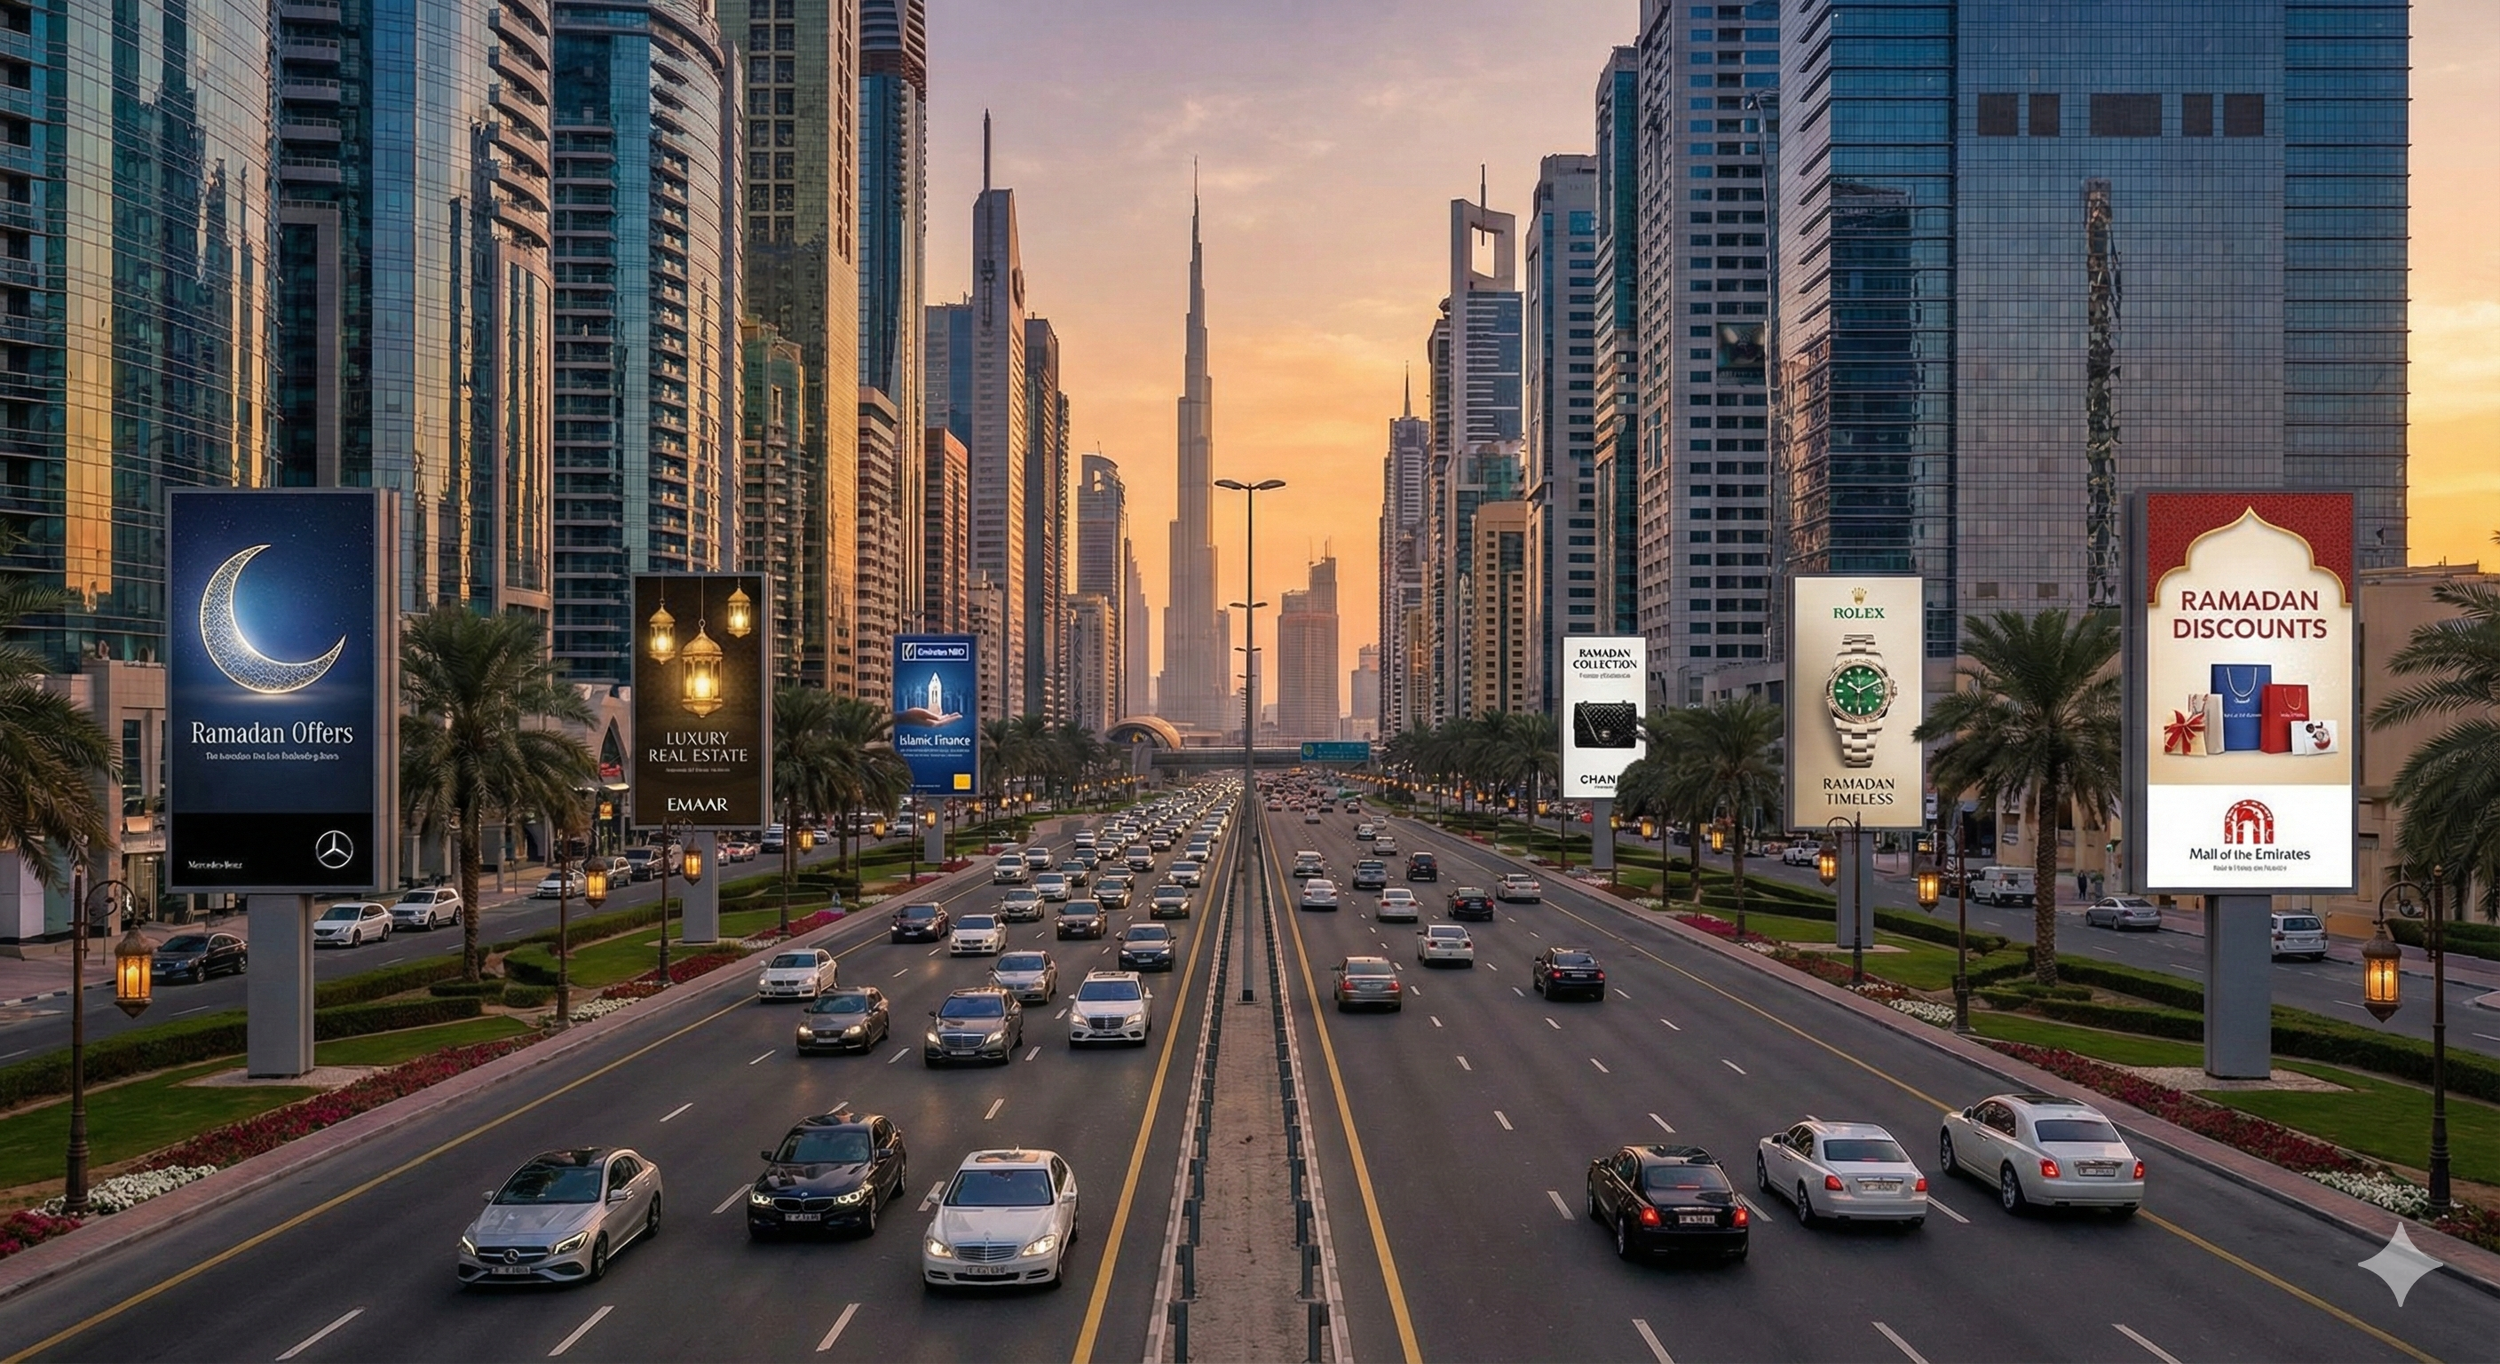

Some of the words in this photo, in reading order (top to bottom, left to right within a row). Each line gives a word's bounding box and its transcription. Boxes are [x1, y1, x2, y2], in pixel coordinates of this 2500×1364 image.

[2181, 590, 2319, 611] RAMADAN
[1833, 607, 1885, 619] ROLEX
[2173, 618, 2328, 639] DISCOUNTS
[1579, 648, 1631, 658] RAMADAN
[1573, 659, 1637, 669] COLLECTION
[191, 721, 285, 744] Ramadan
[292, 721, 354, 744] Offers
[666, 731, 730, 746] LUXURY
[899, 733, 933, 746] Islamic
[934, 733, 971, 746] Finance
[649, 748, 687, 762] REAL
[693, 748, 748, 762] ESTATE
[1823, 778, 1895, 790] RAMADAN
[667, 797, 729, 812] EMAAR
[1825, 793, 1894, 805] TIMELESS
[2189, 848, 2217, 860] Mall
[2220, 849, 2231, 860] of
[2234, 849, 2252, 860] the
[2256, 848, 2311, 860] Emirates
